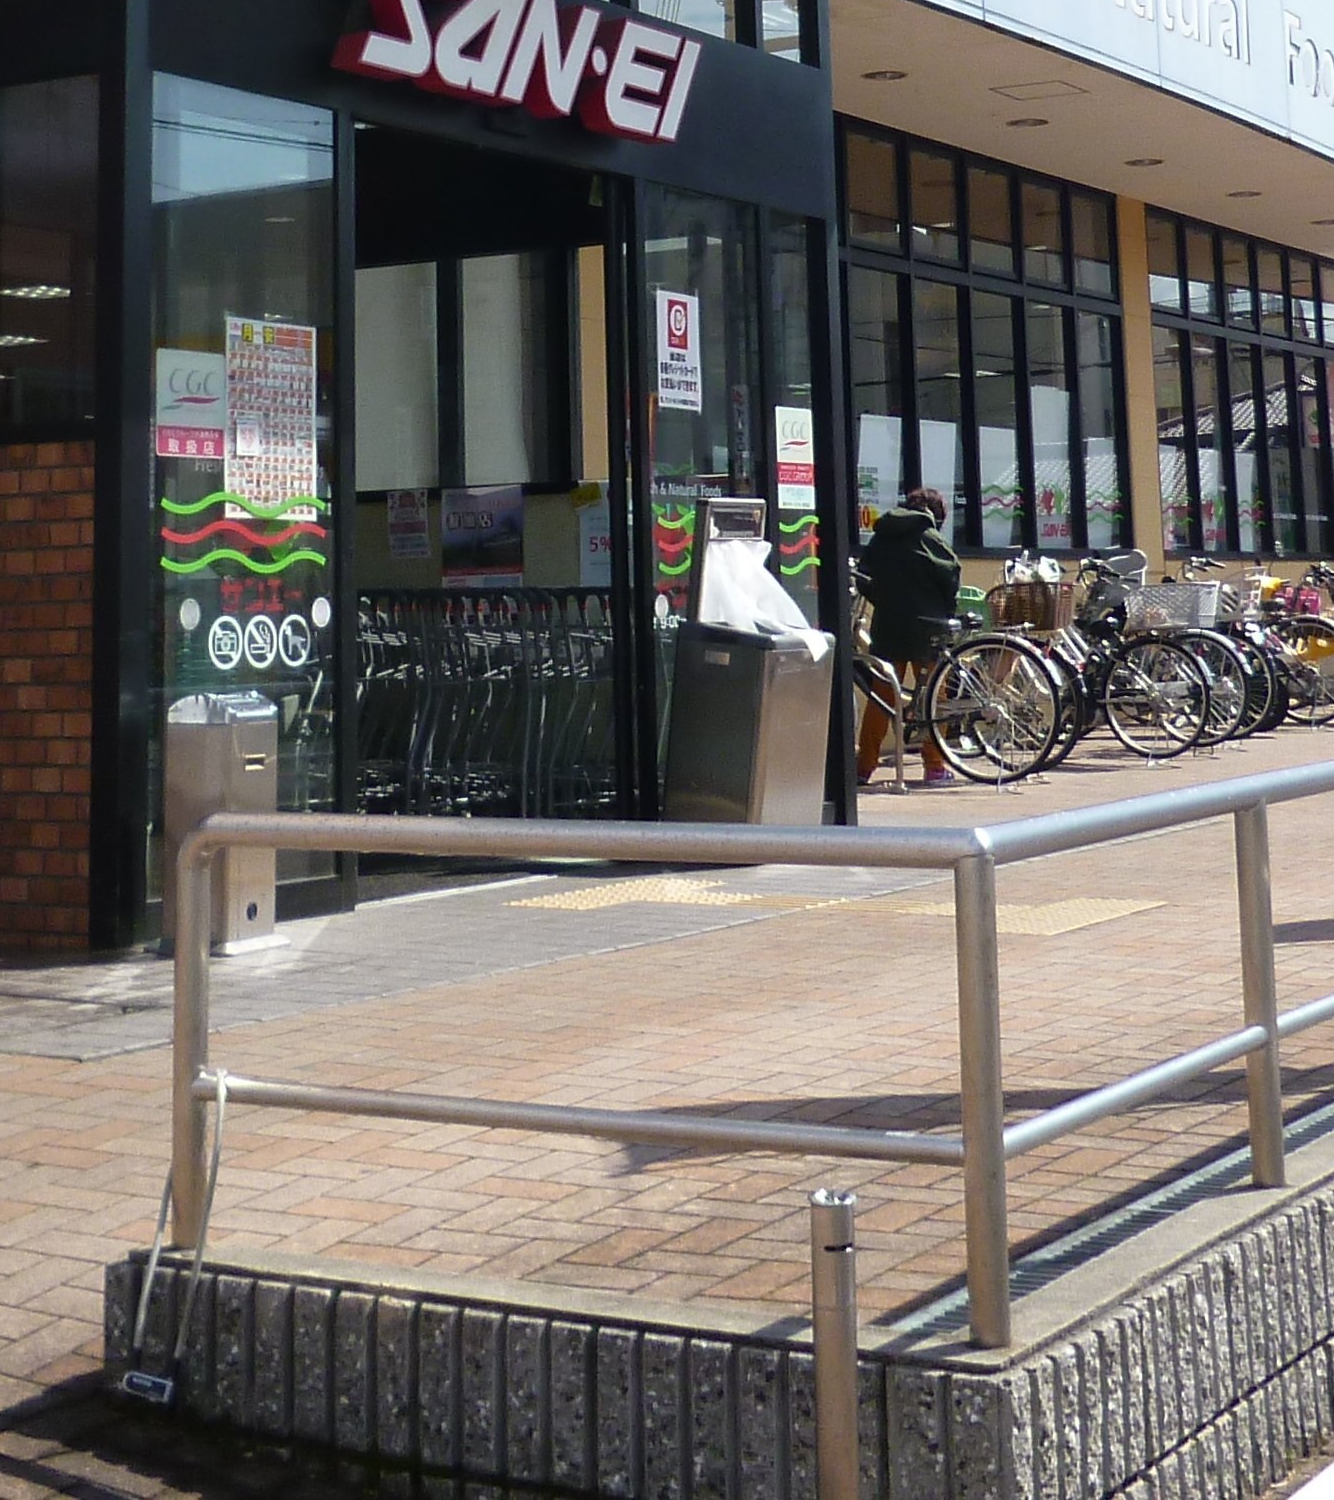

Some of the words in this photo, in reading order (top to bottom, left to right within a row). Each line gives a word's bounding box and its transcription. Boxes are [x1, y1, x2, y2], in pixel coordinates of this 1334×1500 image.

[169, 368, 217, 396] CGC
[782, 420, 810, 440] CGC
[167, 438, 215, 455] 取扱店
[668, 483, 697, 496] Natural
[700, 484, 722, 497] Foods
